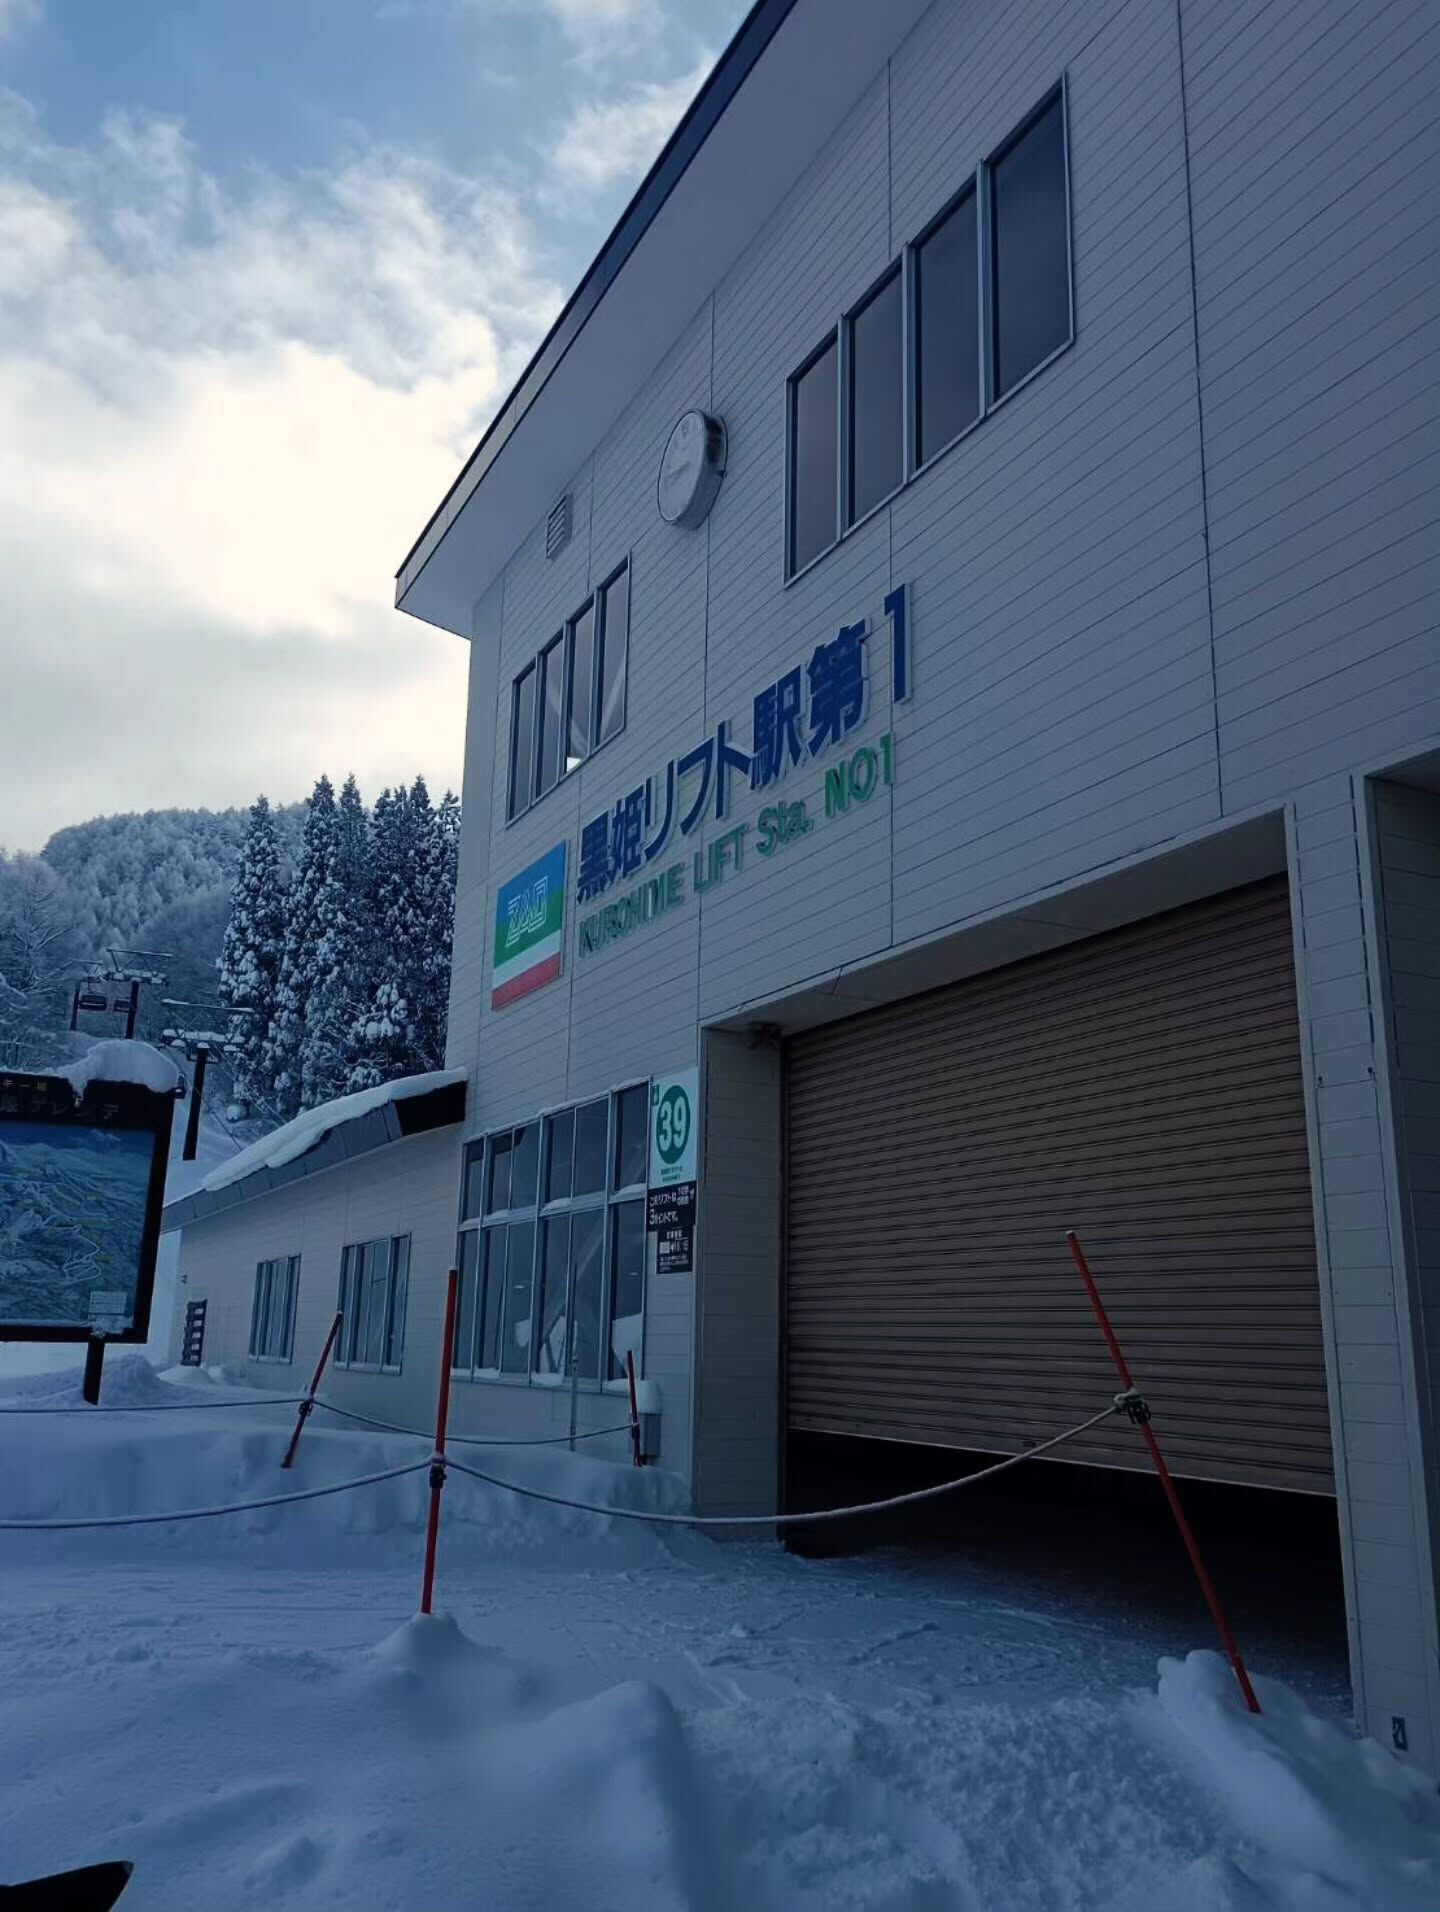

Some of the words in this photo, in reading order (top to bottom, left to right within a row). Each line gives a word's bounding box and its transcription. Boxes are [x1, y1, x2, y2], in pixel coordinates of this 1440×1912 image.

[578, 584, 908, 903] 黒姫リフト駅第1
[579, 864, 685, 956] KUROHIME
[694, 826, 747, 893] LIFT
[758, 801, 812, 856] Sta.
[659, 1096, 686, 1151] 39
